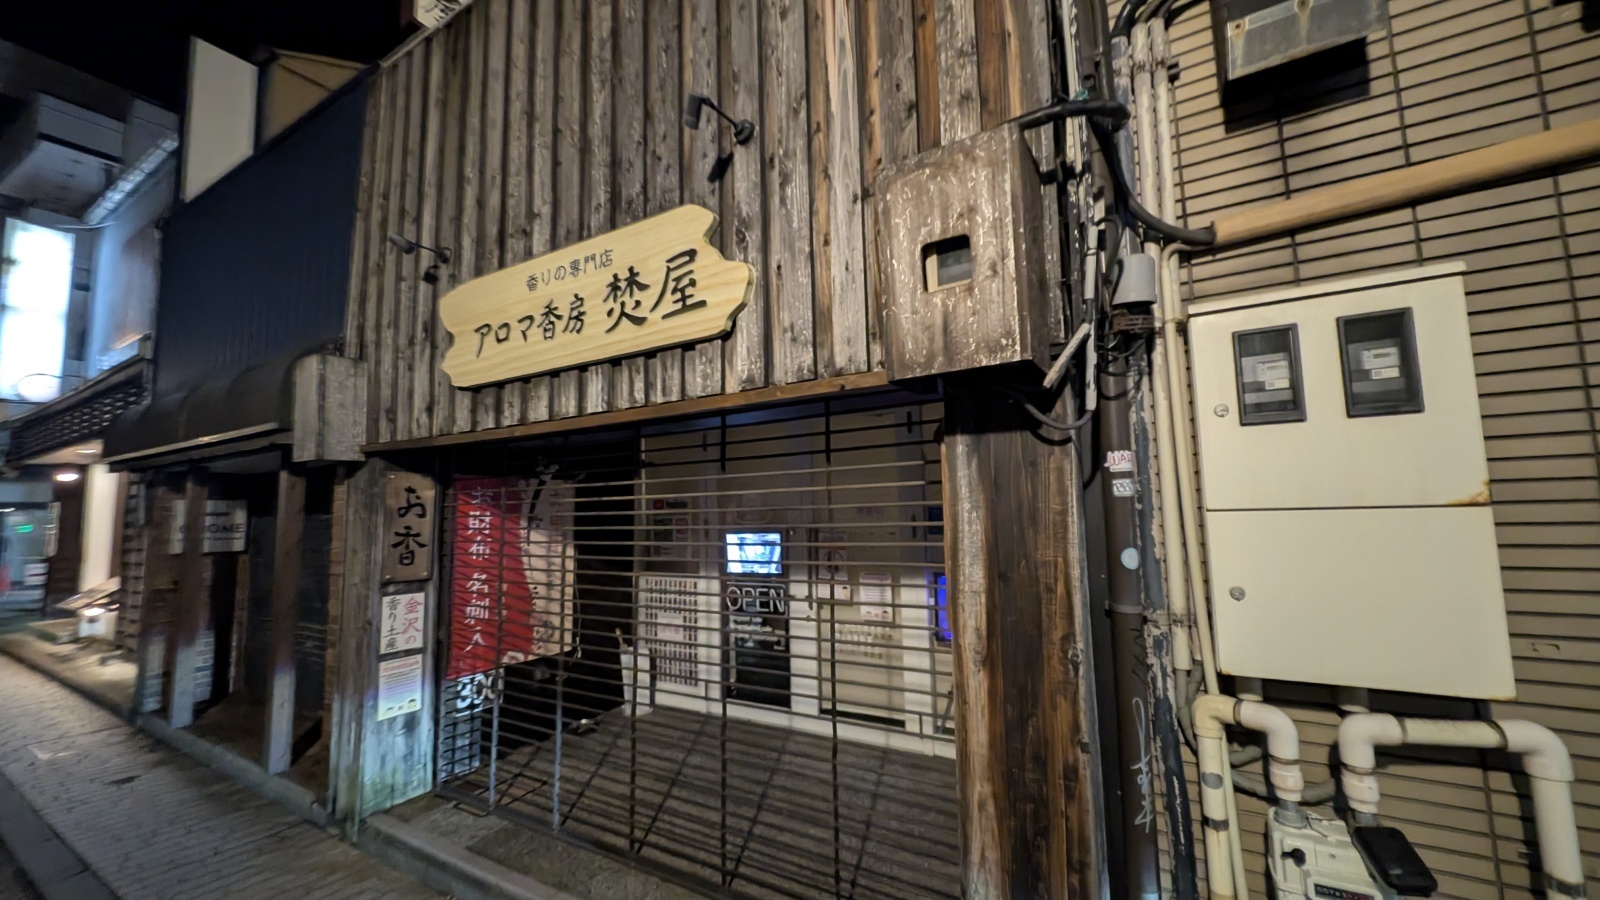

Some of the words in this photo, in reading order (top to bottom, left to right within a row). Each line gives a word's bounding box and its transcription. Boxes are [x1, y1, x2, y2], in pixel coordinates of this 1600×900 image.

[526, 249, 614, 292] 香りの専門店
[474, 293, 587, 358] アロマ香房
[602, 248, 708, 334] 焚屋
[391, 486, 429, 567] お香
[382, 597, 403, 652] 香り土産
[402, 596, 424, 645] 金沢の
[726, 586, 786, 613] OPEN
